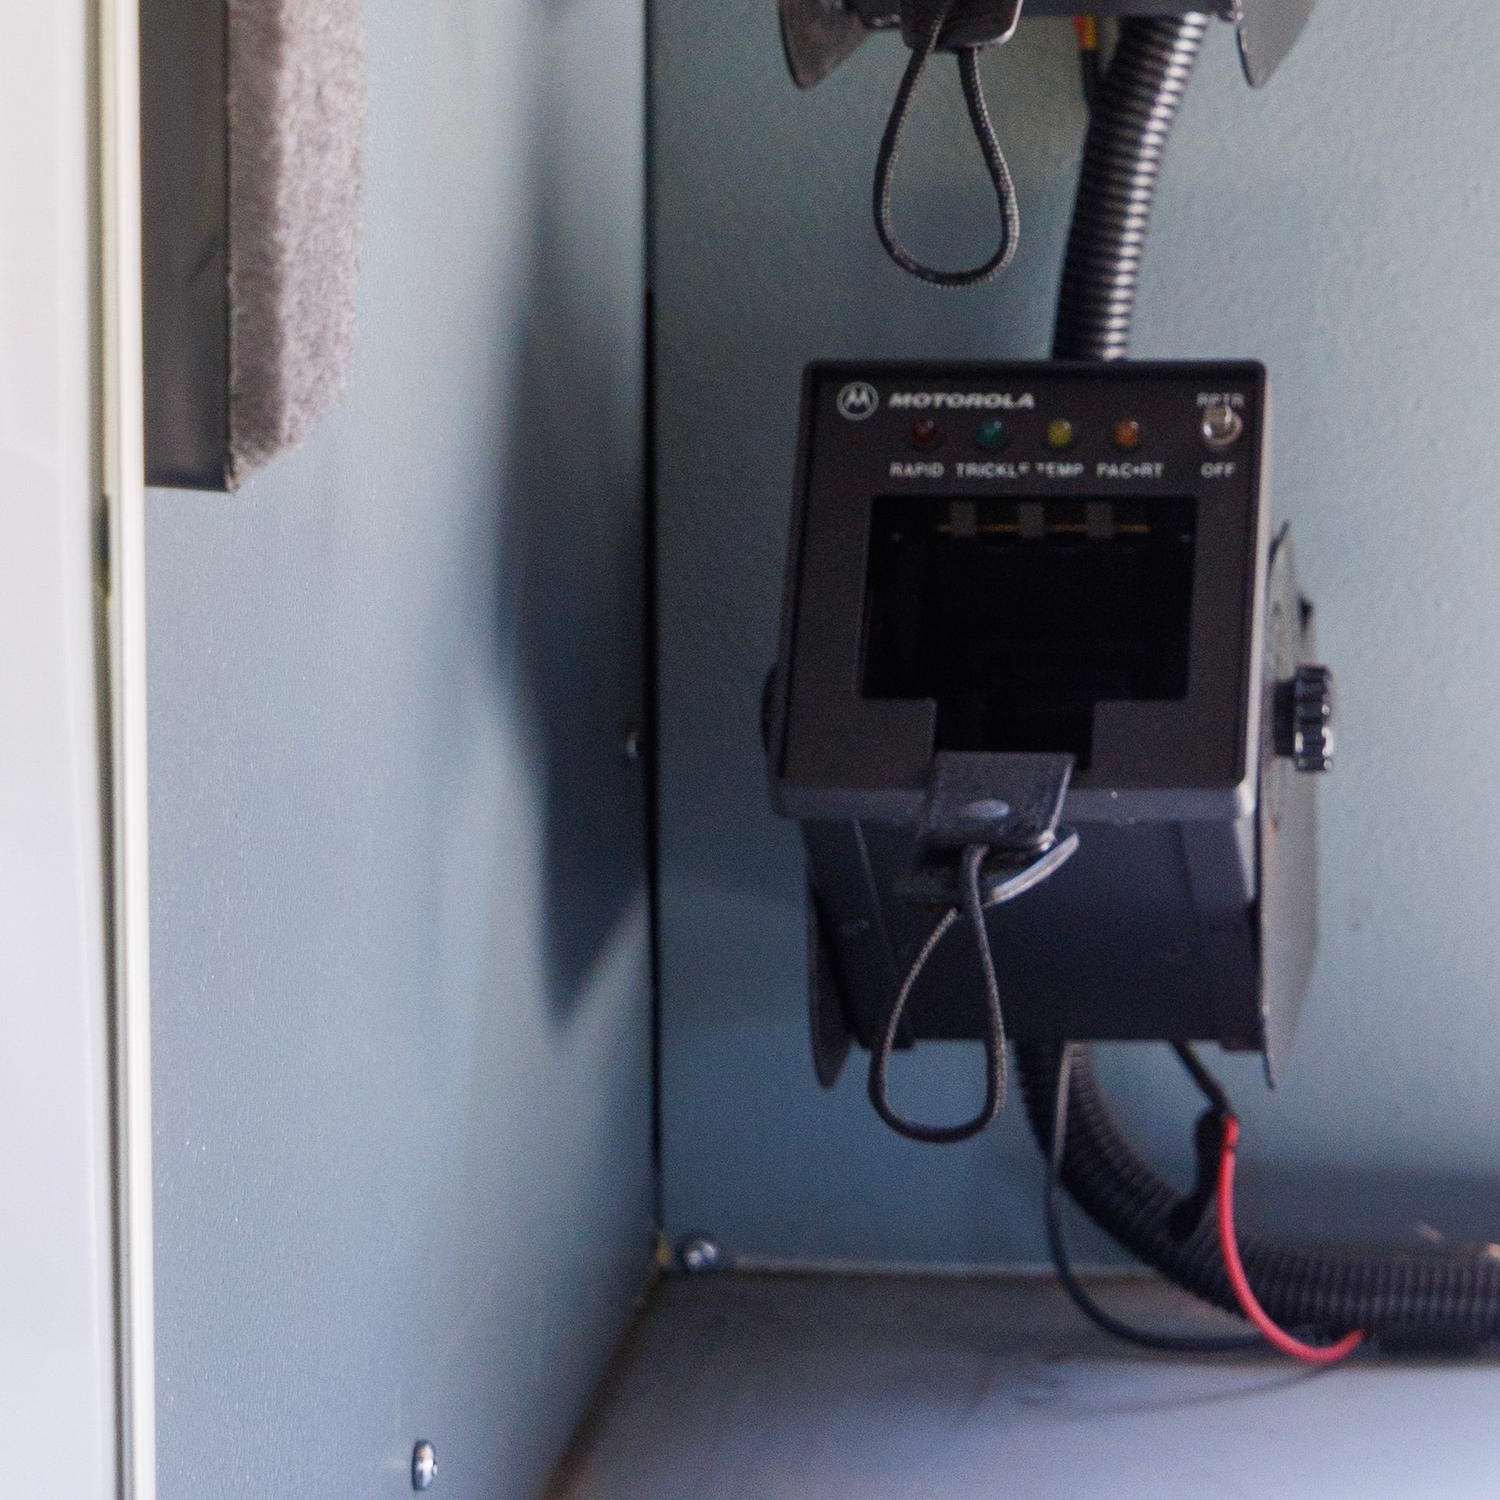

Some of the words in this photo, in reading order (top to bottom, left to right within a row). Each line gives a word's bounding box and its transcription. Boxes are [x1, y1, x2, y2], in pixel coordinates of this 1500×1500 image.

[888, 392, 1035, 409] MOTOROLA
[889, 461, 945, 478] RAPID
[1034, 461, 1084, 478] TEMP
[1200, 461, 1237, 479] OFF
